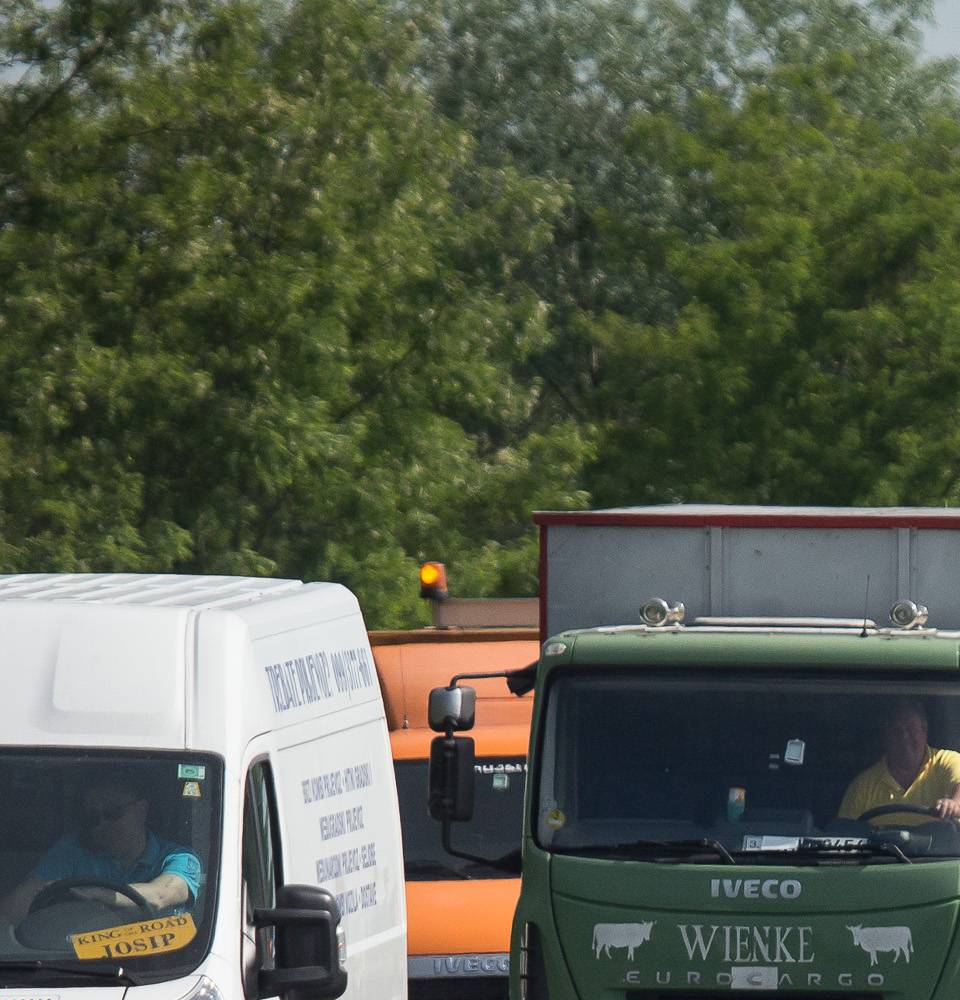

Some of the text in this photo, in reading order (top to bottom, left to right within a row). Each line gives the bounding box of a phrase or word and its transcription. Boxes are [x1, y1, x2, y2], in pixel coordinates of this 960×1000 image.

[711, 878, 802, 899] IVECO
[78, 930, 121, 945] KING
[139, 917, 188, 933] ROAD
[677, 924, 815, 964] WIENKE
[103, 932, 176, 959] JOSIP
[625, 970, 885, 987] EUROCARGO
